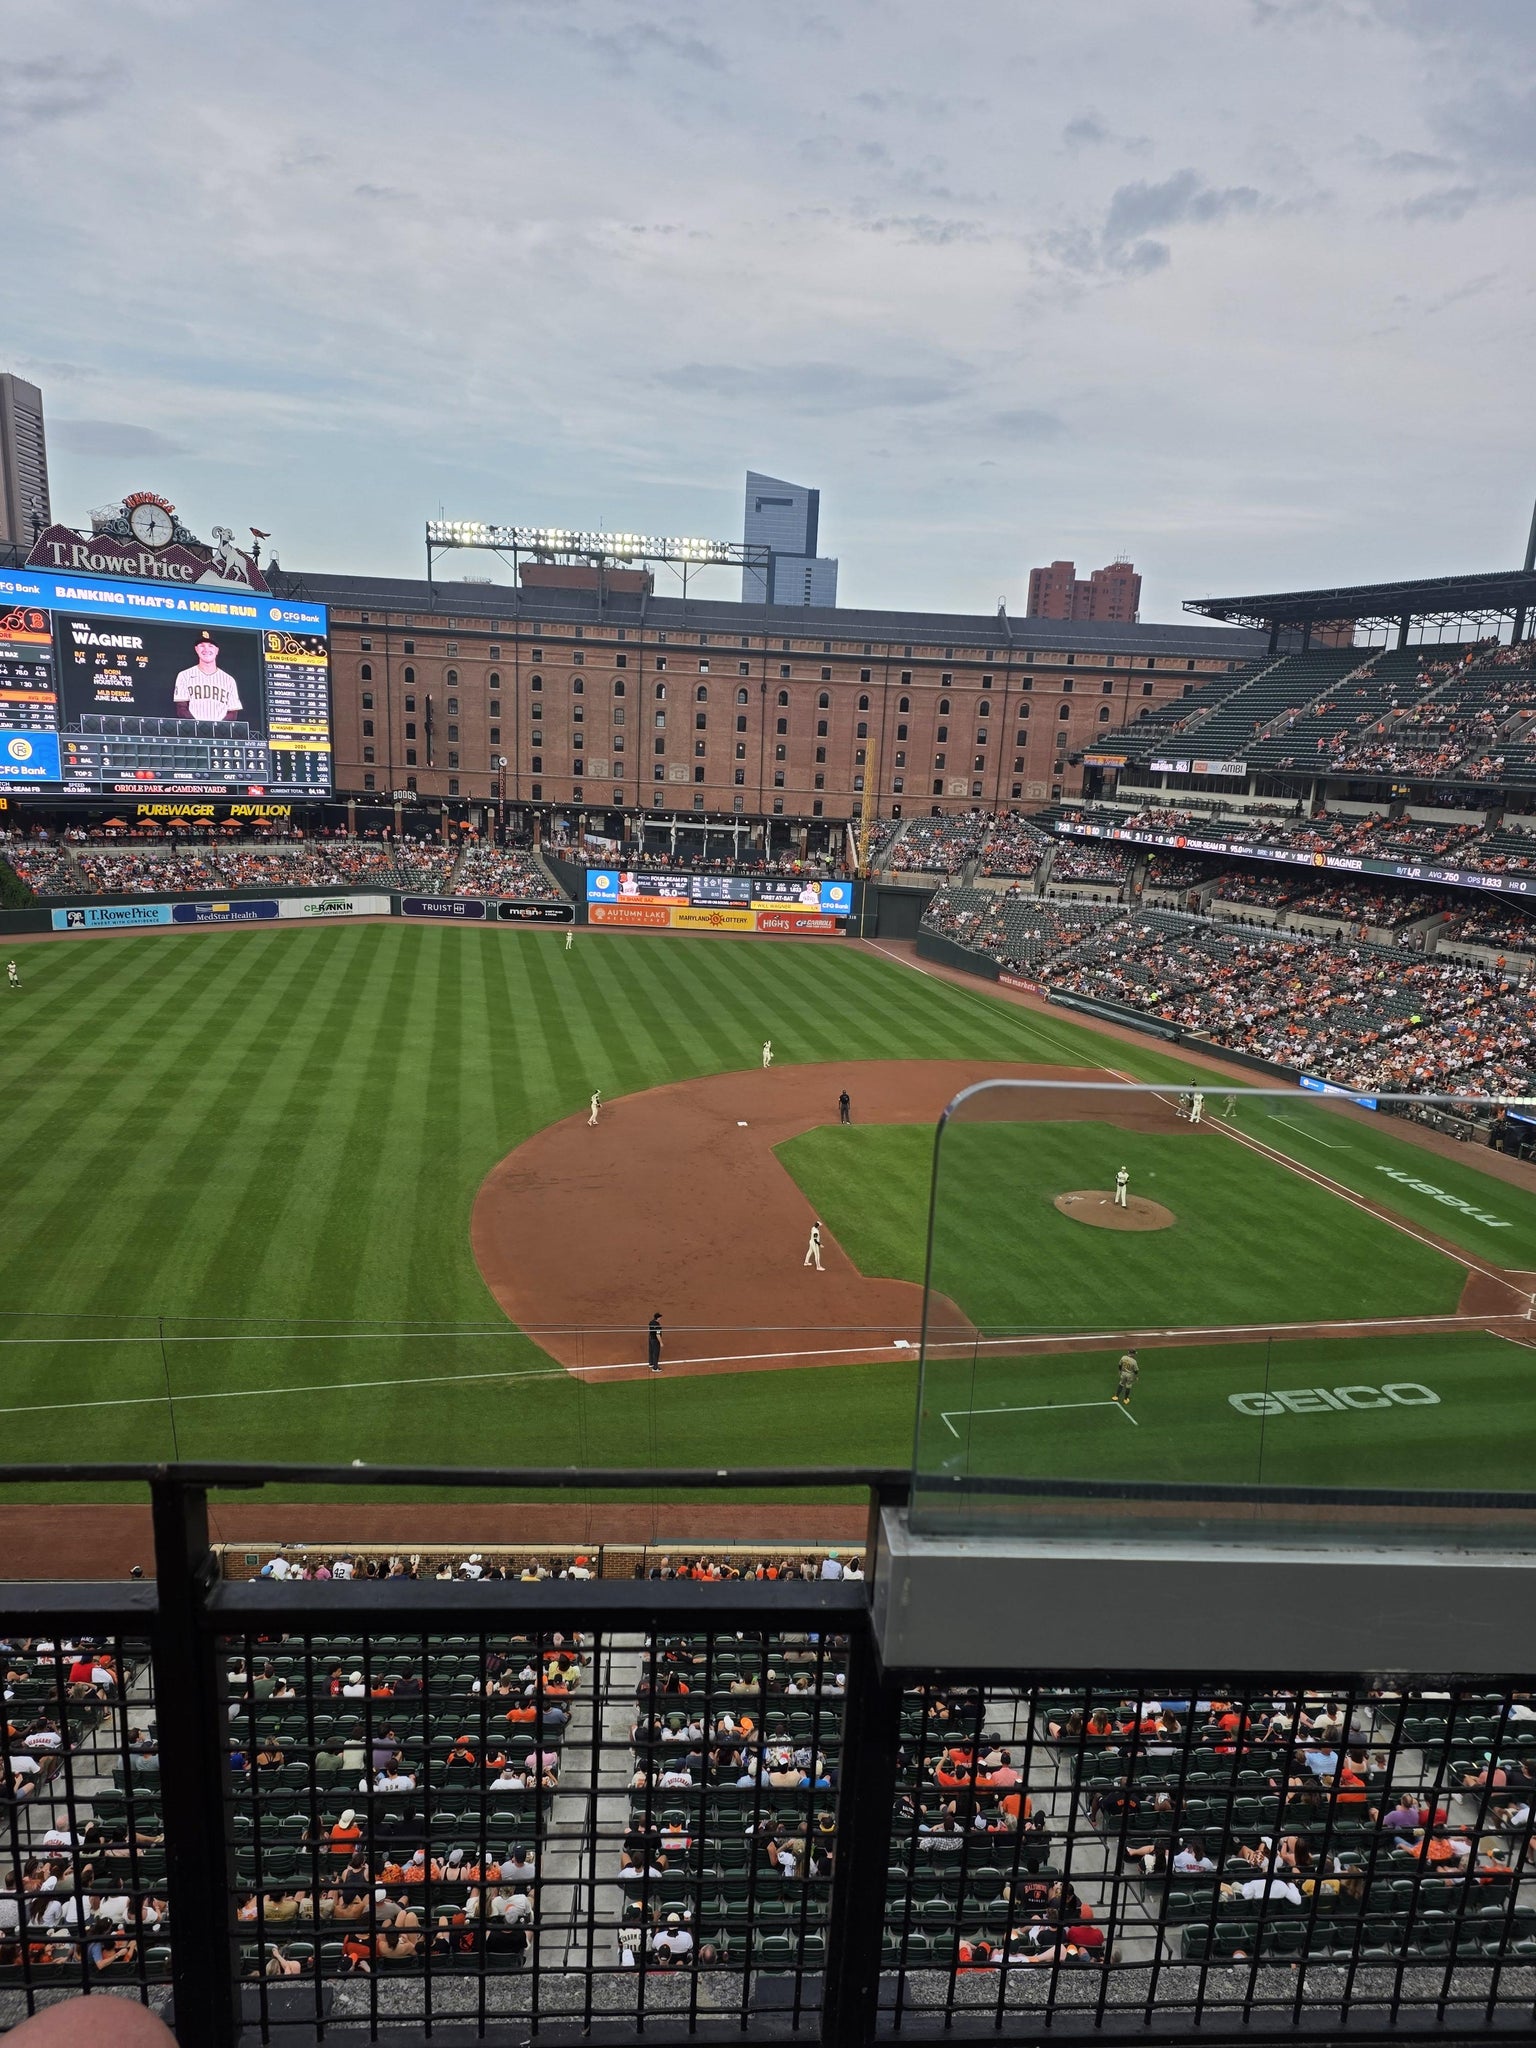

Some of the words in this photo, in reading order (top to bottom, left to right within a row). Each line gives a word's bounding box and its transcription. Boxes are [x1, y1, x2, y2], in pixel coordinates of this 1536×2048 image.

[16, 583, 40, 594] Bank
[55, 587, 124, 604] BANKING
[127, 594, 175, 609] THAT'S
[177, 599, 187, 611] A
[190, 602, 227, 614] HOME
[230, 606, 257, 618] RUN
[283, 611, 299, 621] CFG
[301, 613, 319, 623] Bank
[71, 622, 91, 631] WILL
[72, 631, 143, 649] WAGNER
[103, 745, 108, 753] 1
[223, 749, 229, 757] 2
[21, 766, 47, 775] Bank
[1221, 764, 1244, 773] AMBI
[114, 784, 144, 792] ORIOLE
[172, 785, 203, 793] CAMDEN
[137, 804, 215, 816] PUREWAGER
[230, 805, 291, 816] PAVILION
[1058, 823, 1070, 832] 7:33
[1121, 831, 1131, 839] BAL
[1187, 838, 1218, 850] FOUR-SEAM
[1219, 843, 1226, 851] FB
[1230, 845, 1242, 853] 95.0
[1326, 856, 1362, 869] WAGNER
[1407, 867, 1420, 877] L/R
[1442, 872, 1459, 881] .750
[1467, 876, 1480, 884] OPS
[1508, 881, 1519, 889] HR
[1519, 882, 1526, 891] 0
[659, 888, 677, 896] 95.0
[318, 902, 353, 911] RANKIN
[421, 903, 452, 912] TRUIST
[131, 908, 159, 919] Price
[196, 912, 230, 921] MedStar
[231, 911, 258, 919] Health
[607, 909, 642, 917] AUTUMN
[645, 911, 666, 919] LAKE
[762, 919, 789, 929] HIGH'S
[1012, 980, 1036, 991] markets
[1227, 1382, 1442, 1416] GEICO
[334, 1567, 346, 1578] 42
